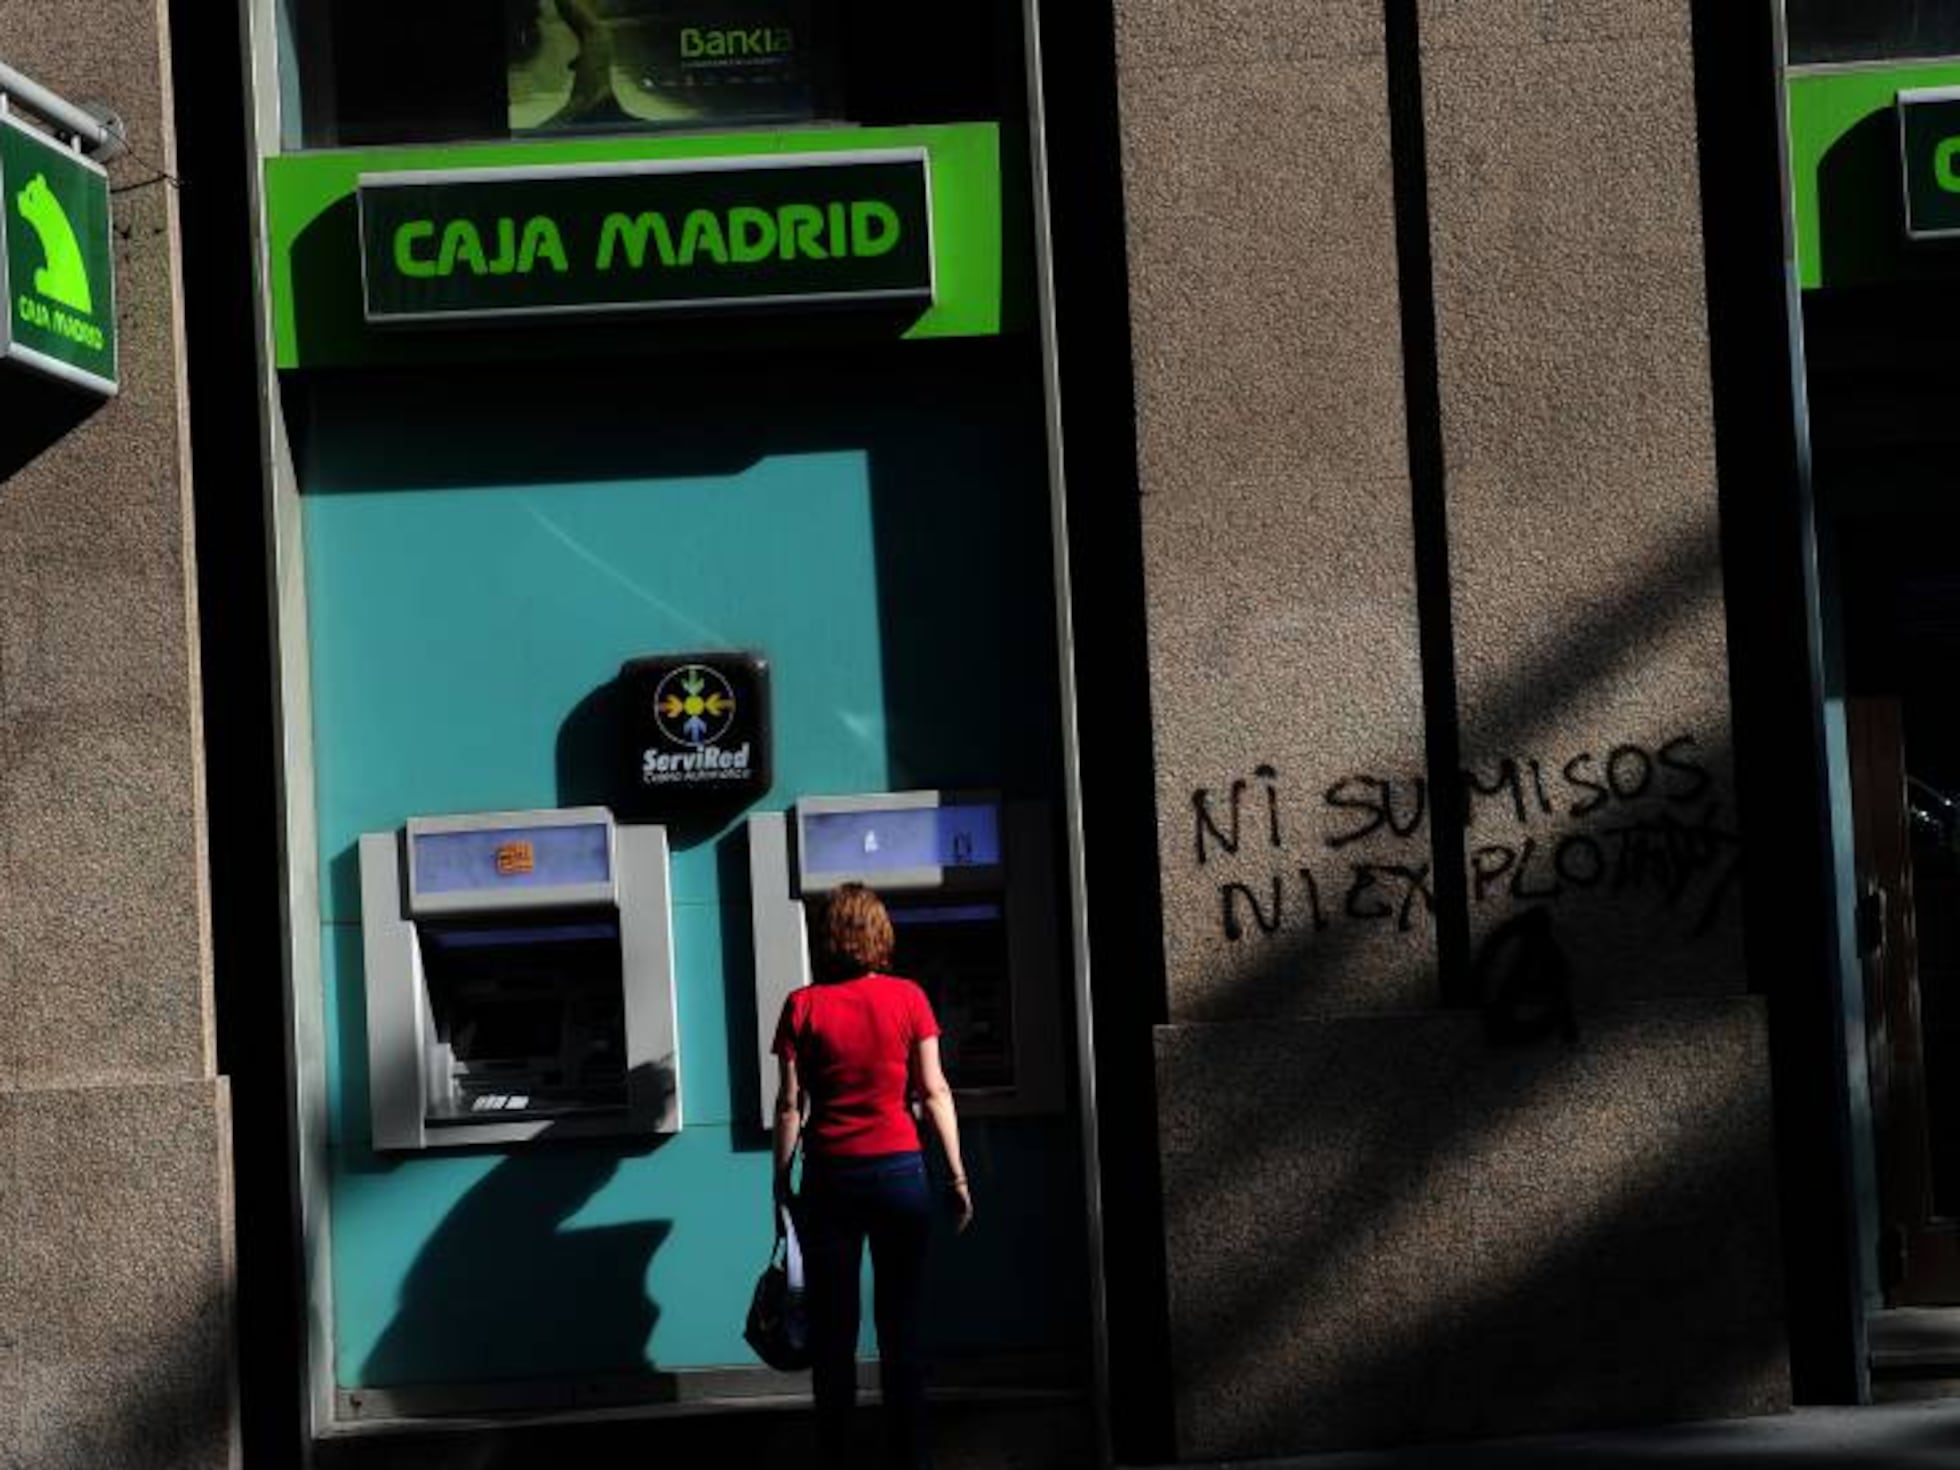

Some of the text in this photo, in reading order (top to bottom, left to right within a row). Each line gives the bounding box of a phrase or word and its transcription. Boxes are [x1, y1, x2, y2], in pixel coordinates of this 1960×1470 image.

[679, 27, 793, 57] Bankia
[393, 200, 901, 278] CAJA MADRID
[19, 294, 51, 333] CAJA
[642, 741, 752, 773] ServiRed
